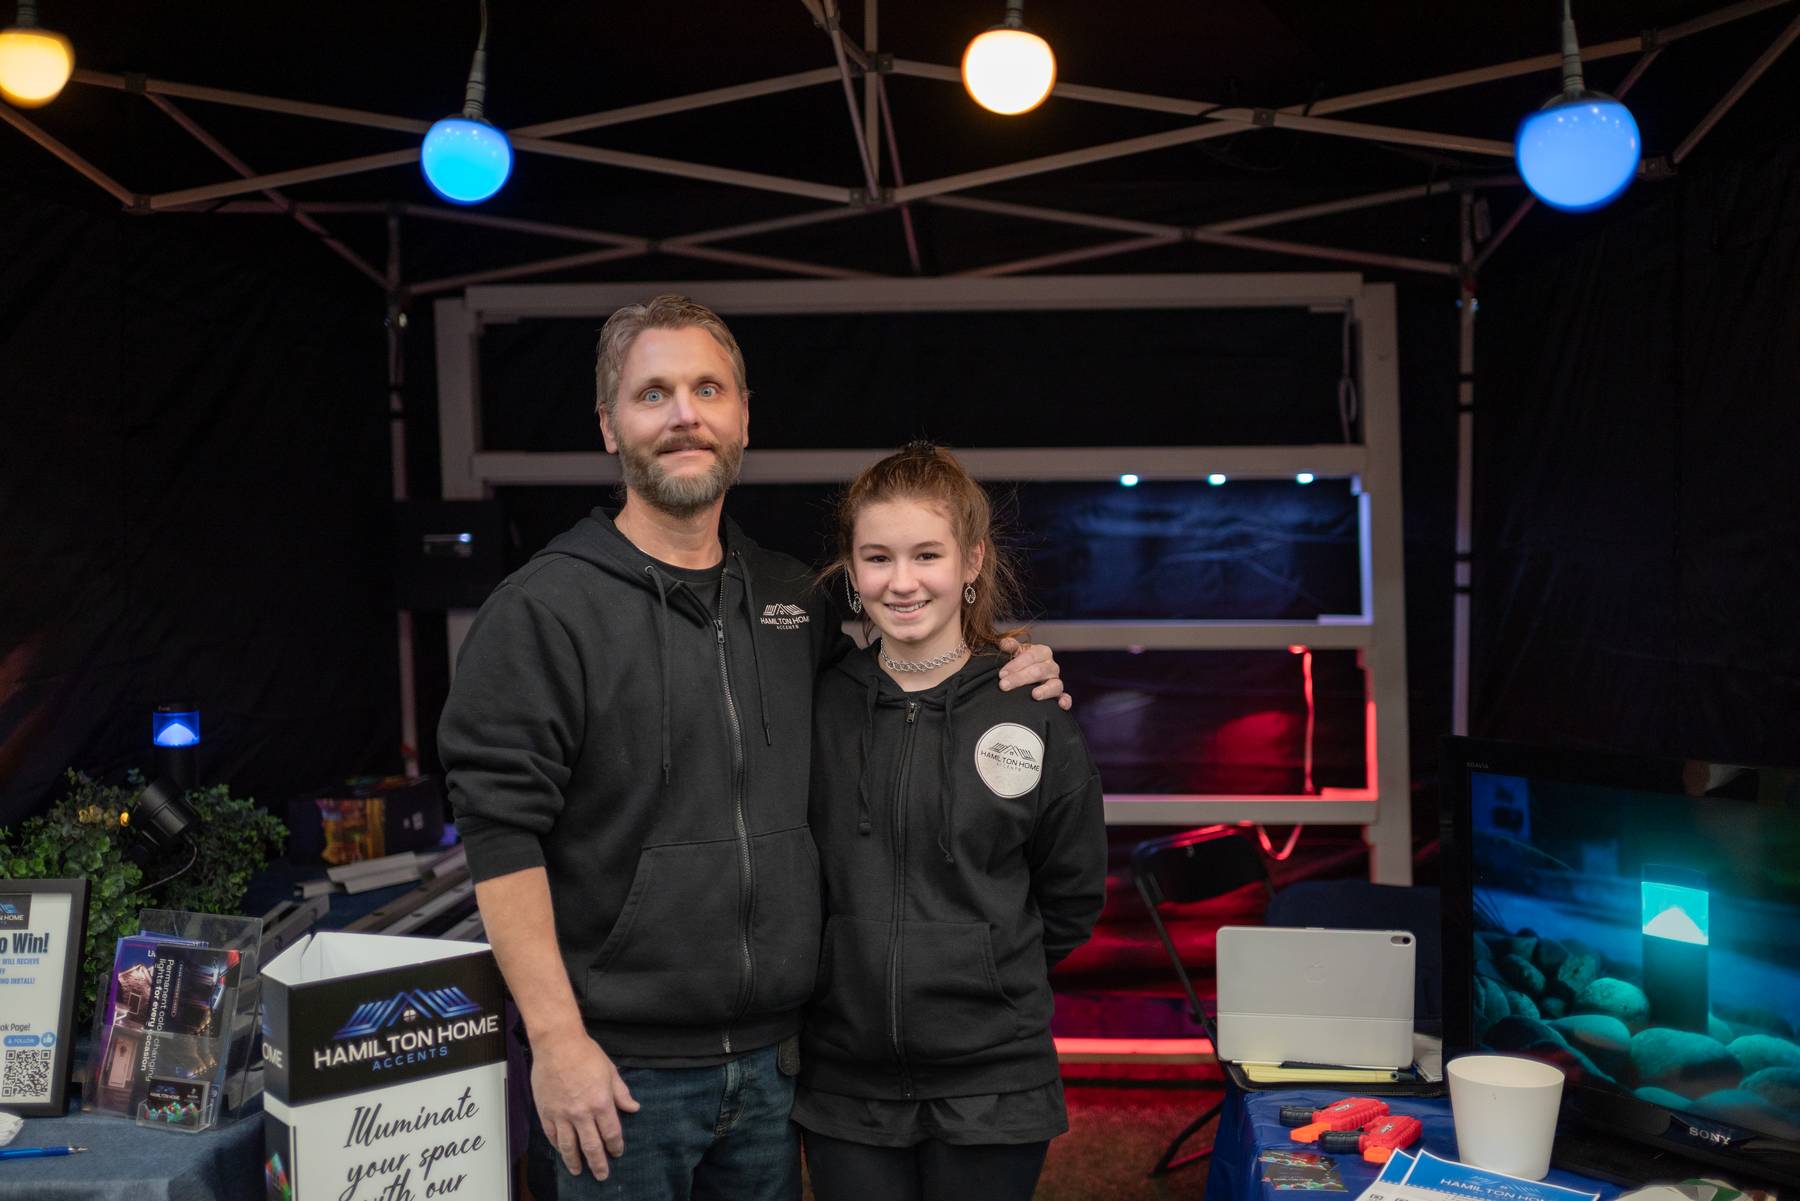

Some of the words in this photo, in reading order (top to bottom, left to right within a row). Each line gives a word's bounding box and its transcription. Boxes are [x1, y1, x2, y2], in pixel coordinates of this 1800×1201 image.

[760, 617, 792, 625] HAMILTON
[980, 750, 1017, 767] HAMILTON
[1018, 760, 1040, 772] HOME
[12, 932, 50, 954] Win!
[155, 958, 167, 985] lights
[161, 959, 175, 1009] Permanent
[153, 986, 162, 1000] for
[146, 1001, 159, 1028] every
[156, 1011, 165, 1035] colo
[10, 1023, 31, 1032] Page!
[313, 1029, 433, 1070] HAMILTON
[438, 1014, 499, 1043] HOME
[262, 1041, 283, 1069] OME
[372, 1046, 448, 1071] ACCENTS
[343, 1086, 480, 1148] Illuminate
[1689, 1126, 1732, 1145] SONY
[338, 1152, 411, 1201] your
[418, 1134, 487, 1181] space
[425, 1173, 468, 1199] our
[1439, 1178, 1516, 1199] HAMILTON
